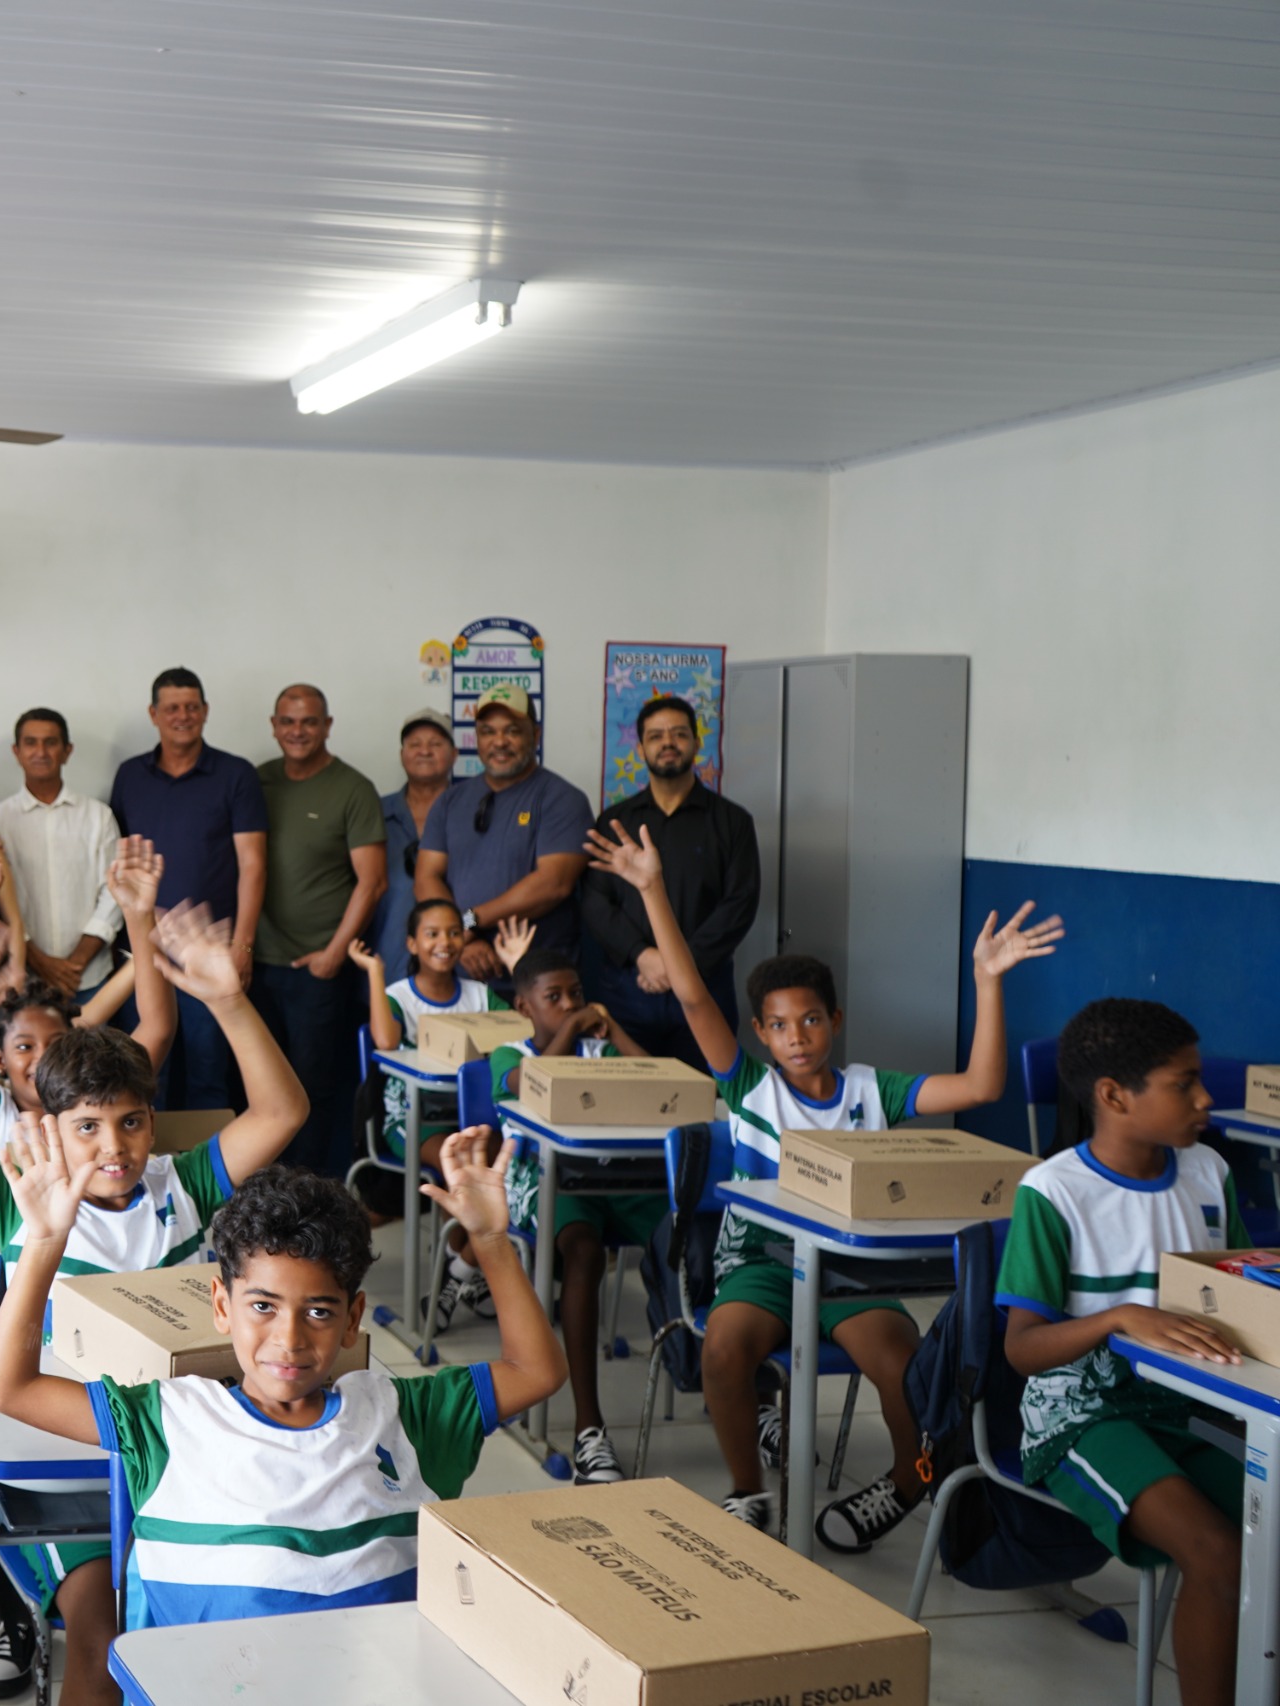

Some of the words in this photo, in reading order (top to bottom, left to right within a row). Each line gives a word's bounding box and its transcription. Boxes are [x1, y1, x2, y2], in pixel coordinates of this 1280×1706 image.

[476, 650, 517, 664] AMOR
[615, 653, 660, 666] NOSSA
[663, 654, 708, 667] TURMA
[651, 669, 679, 682] ANO
[817, 1164, 842, 1181] ESCOLAR
[644, 1508, 669, 1522] KIT
[665, 1517, 734, 1561] MATERIAL
[728, 1560, 801, 1603] ESCOLAR
[656, 1529, 703, 1555] ANOS
[696, 1550, 744, 1582] FINAIS
[575, 1543, 623, 1569] SÃO
[612, 1569, 703, 1623] MATEUS
[602, 1541, 674, 1588] PREFEITURA
[670, 1585, 698, 1601] DE
[801, 1679, 893, 1706] ESCOLAR
